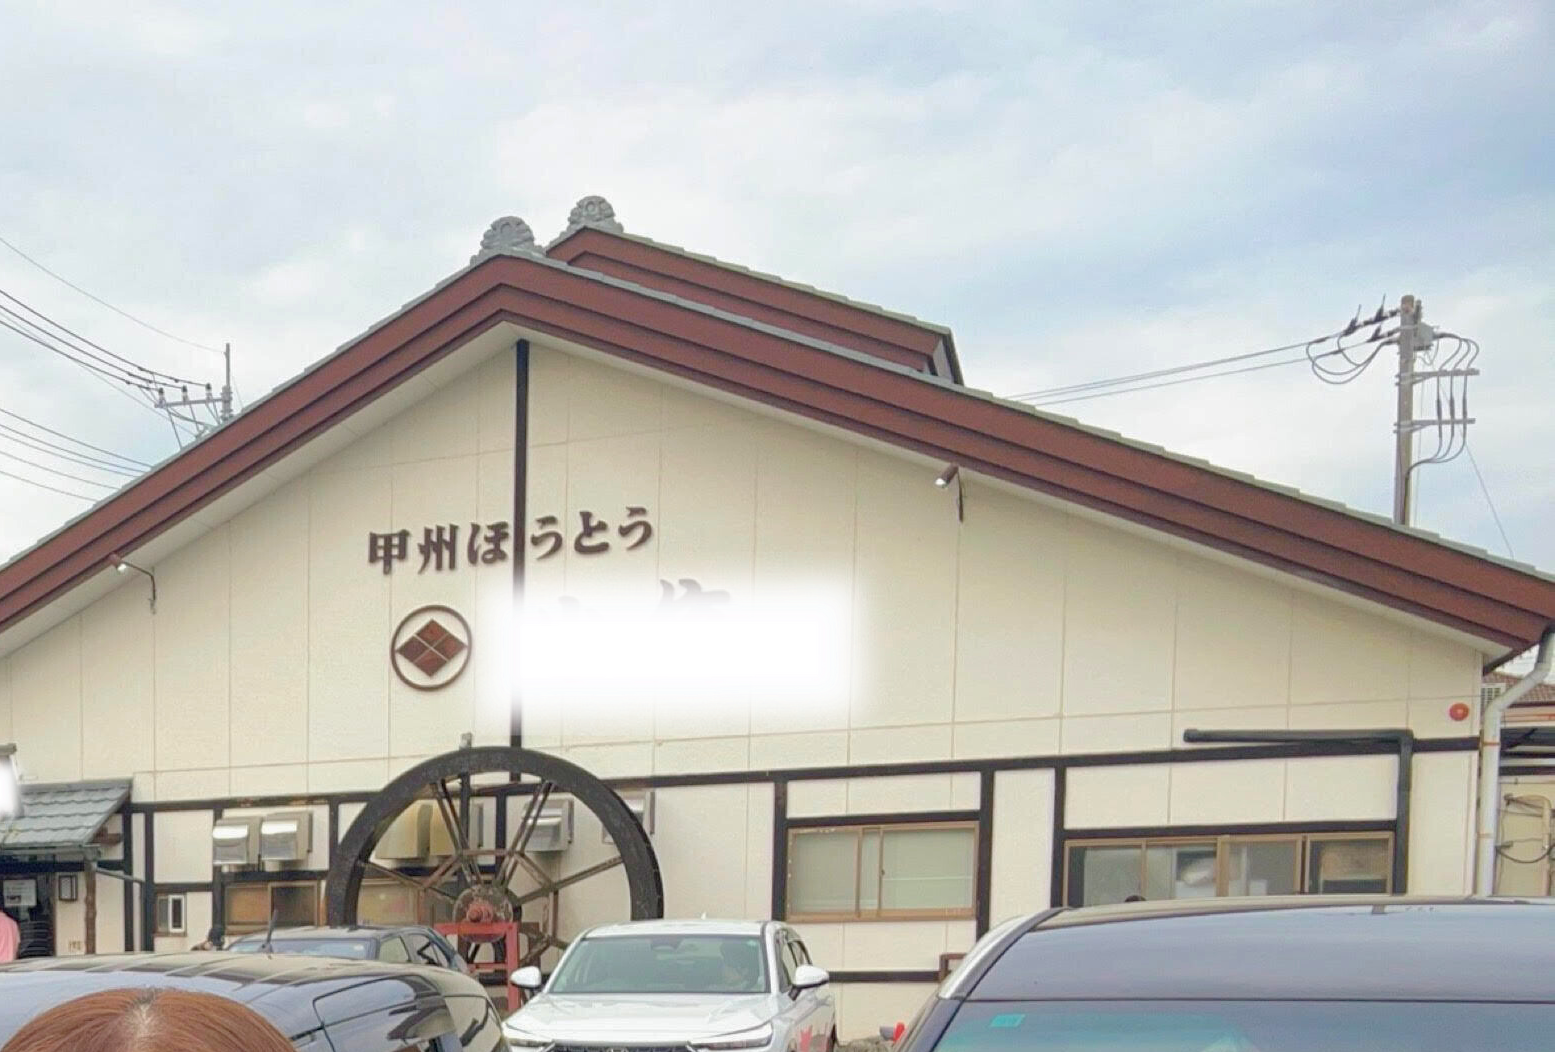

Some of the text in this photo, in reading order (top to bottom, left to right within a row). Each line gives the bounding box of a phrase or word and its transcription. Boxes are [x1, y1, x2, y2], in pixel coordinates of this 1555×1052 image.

[368, 505, 654, 576] 甲州ほうとう
